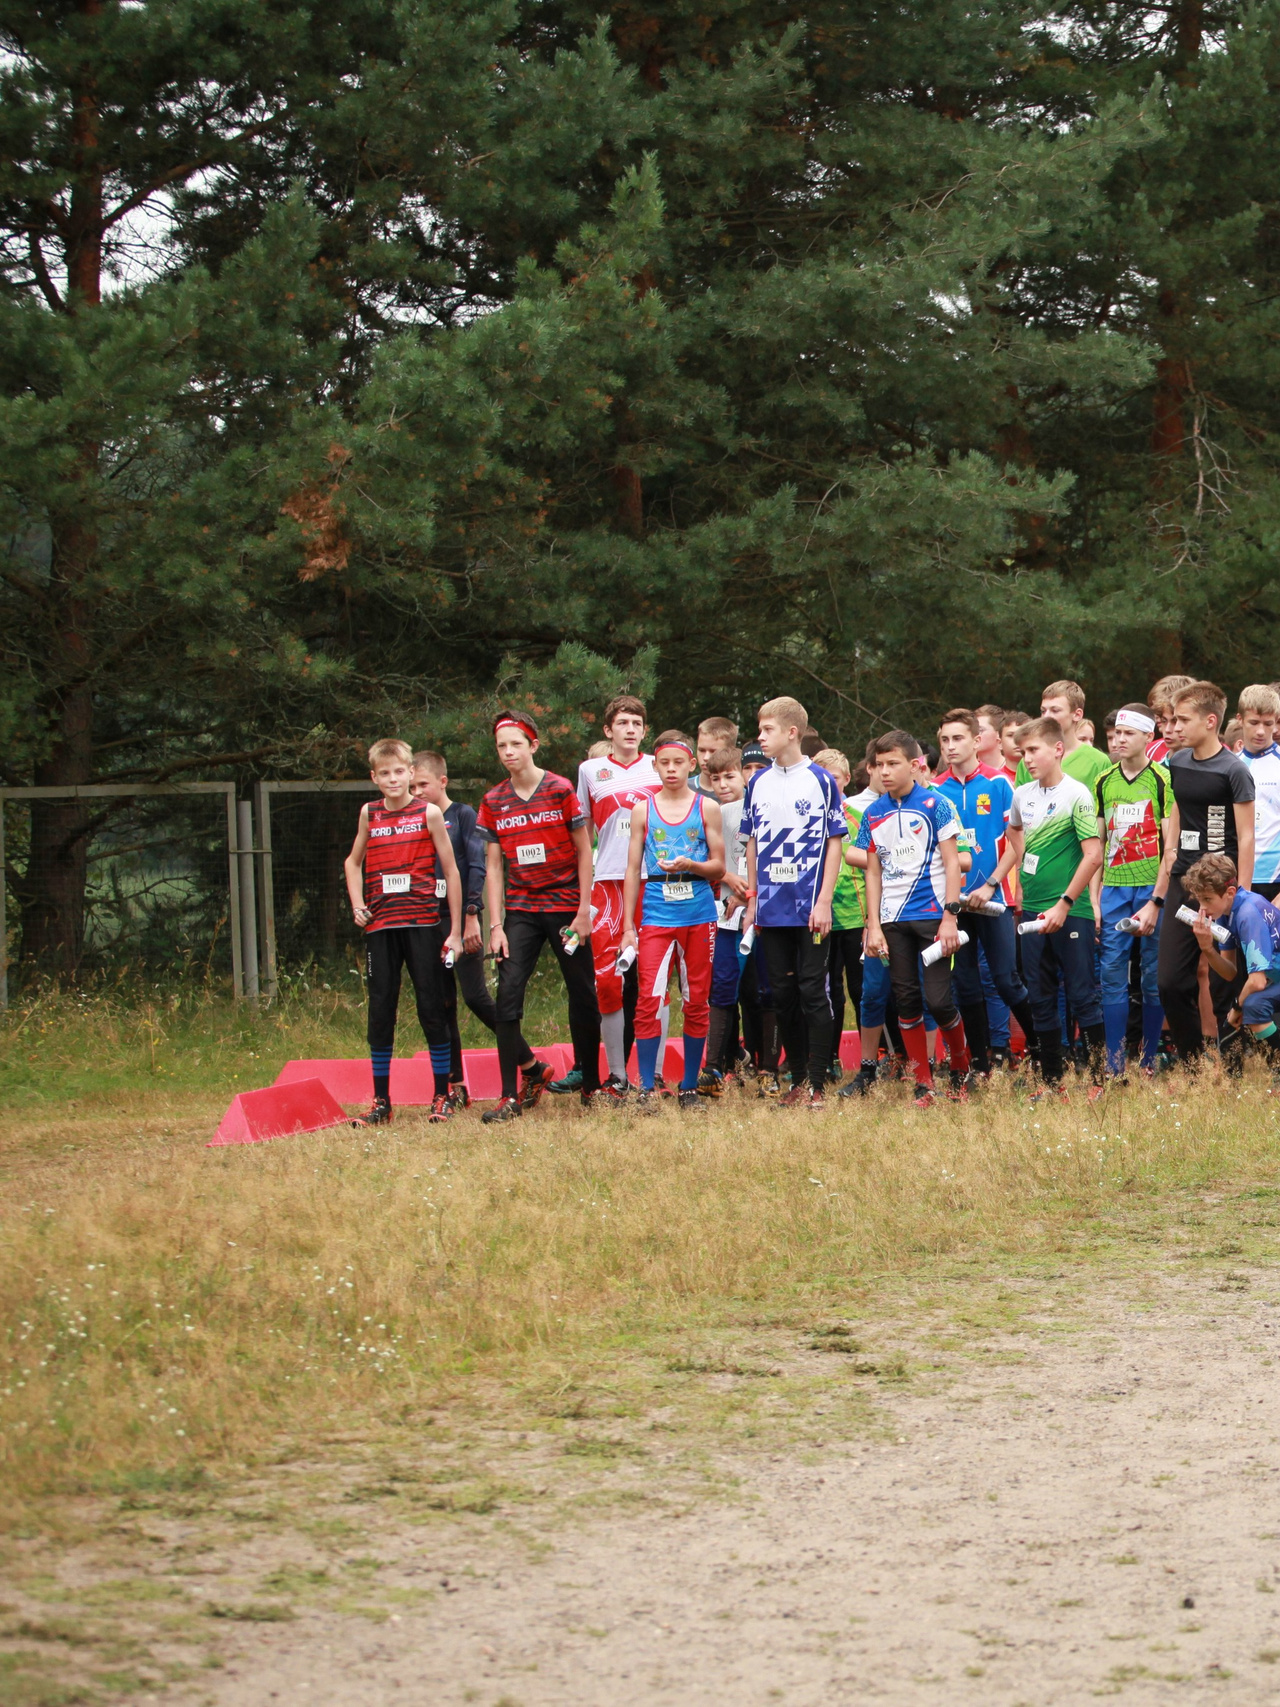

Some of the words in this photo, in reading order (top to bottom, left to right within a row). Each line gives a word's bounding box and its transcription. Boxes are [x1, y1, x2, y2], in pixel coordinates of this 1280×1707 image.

[1121, 808, 1141, 816] 1021
[496, 815, 528, 831] NORD
[529, 809, 564, 824] WEST
[394, 822, 423, 835] WEST
[520, 847, 541, 858] 1002
[895, 845, 915, 857] 1005
[775, 866, 794, 876] 1004
[387, 877, 407, 886] 1001
